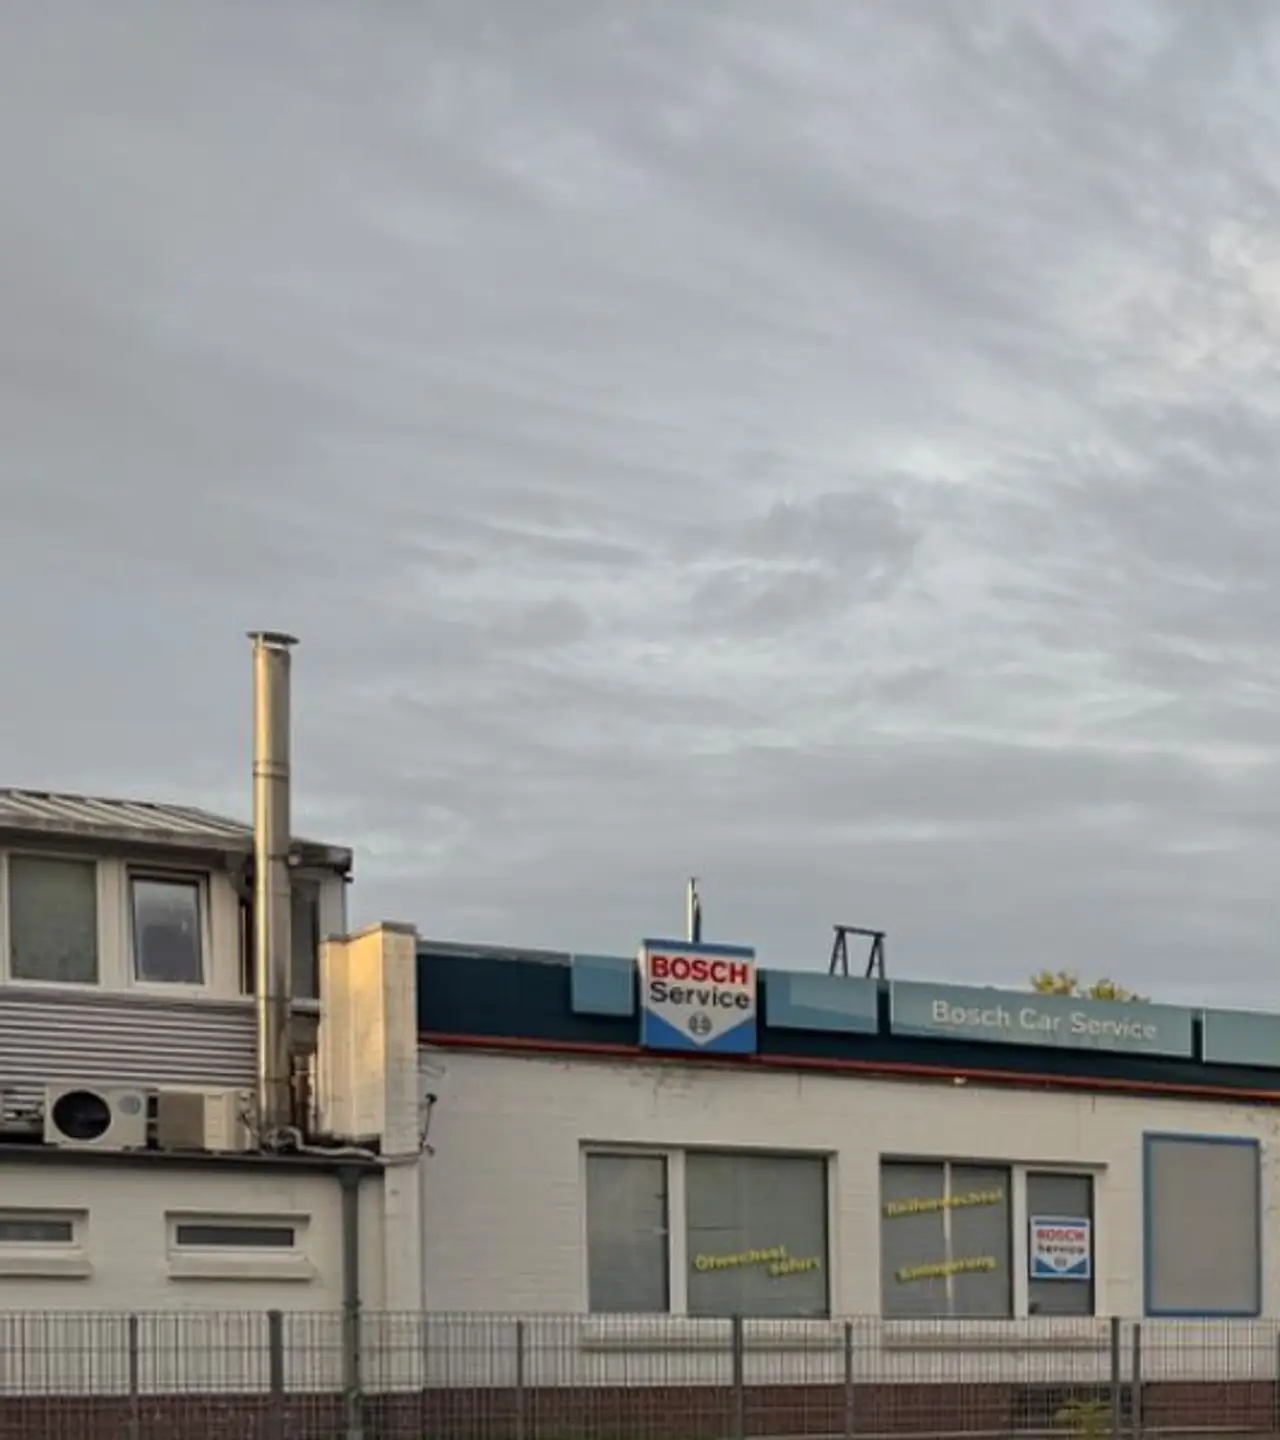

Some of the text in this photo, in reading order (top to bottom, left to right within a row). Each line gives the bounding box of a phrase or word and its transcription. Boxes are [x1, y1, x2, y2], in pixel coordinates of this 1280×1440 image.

[651, 956, 748, 985] BOSCH
[650, 981, 750, 1009] Service
[932, 1000, 1158, 1040] Bosch Car Service
